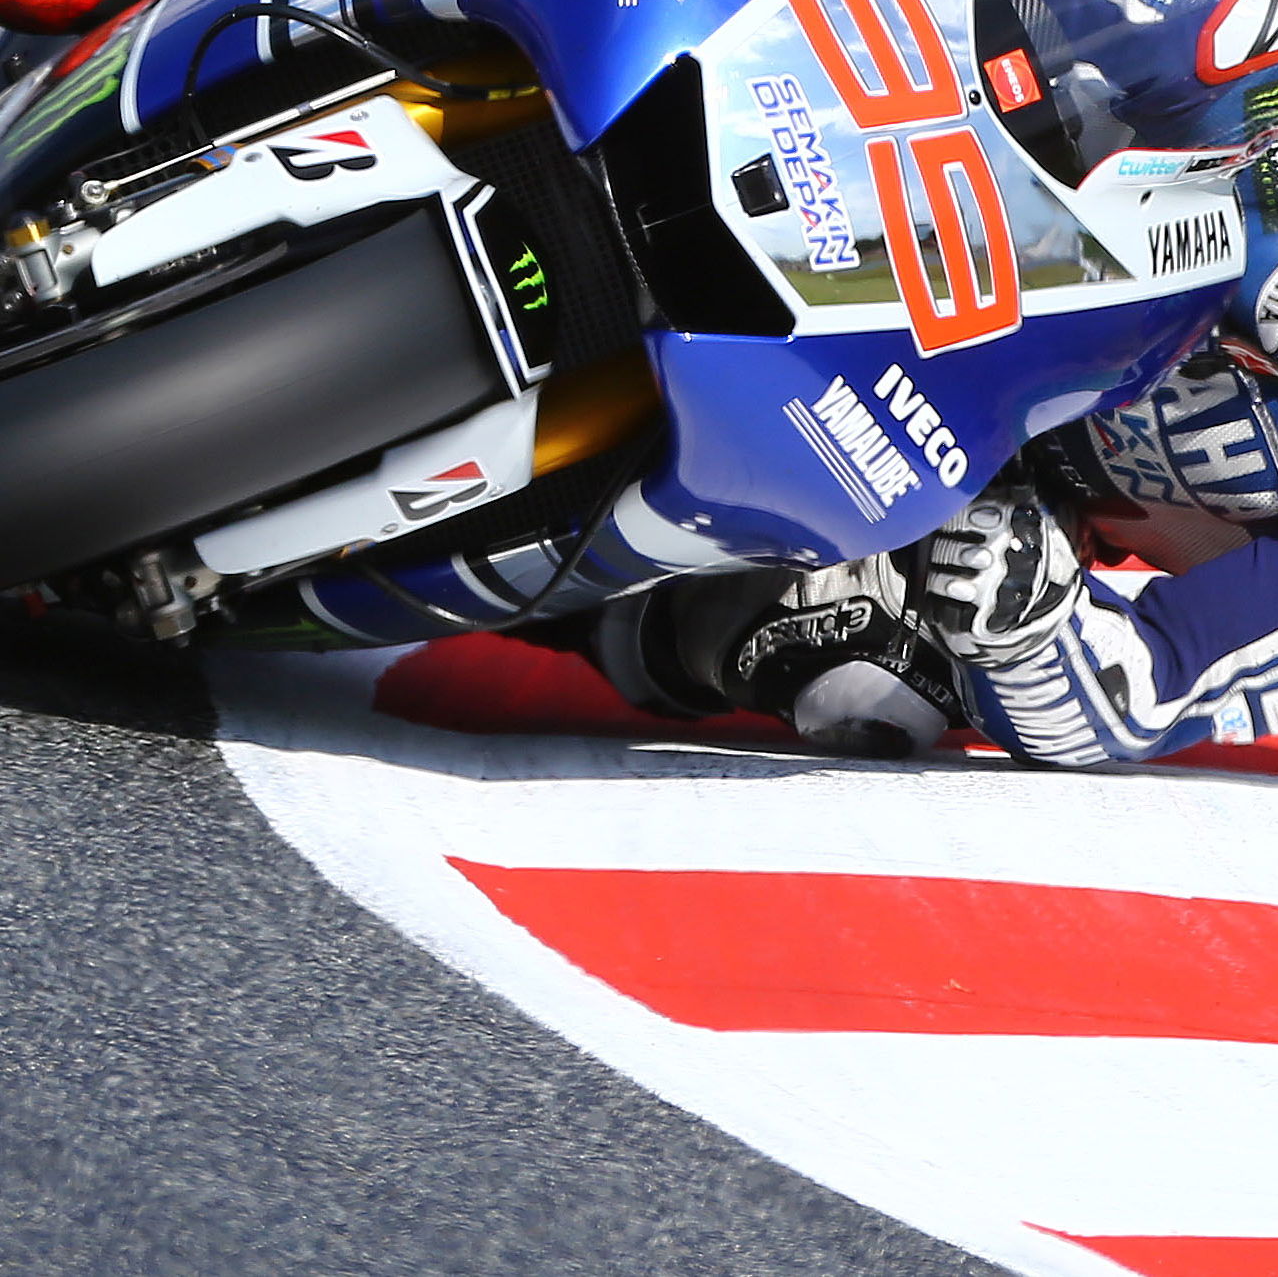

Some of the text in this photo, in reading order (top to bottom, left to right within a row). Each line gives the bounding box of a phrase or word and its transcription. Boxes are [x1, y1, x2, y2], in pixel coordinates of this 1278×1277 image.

[1001, 59, 1025, 103] ENEOS
[770, 125, 833, 267] DEPAN
[1118, 157, 1185, 178] twitter
[1148, 211, 1231, 278] YAMAHA
[812, 375, 919, 508] YAMALUBE
[873, 363, 969, 488] IVECO
